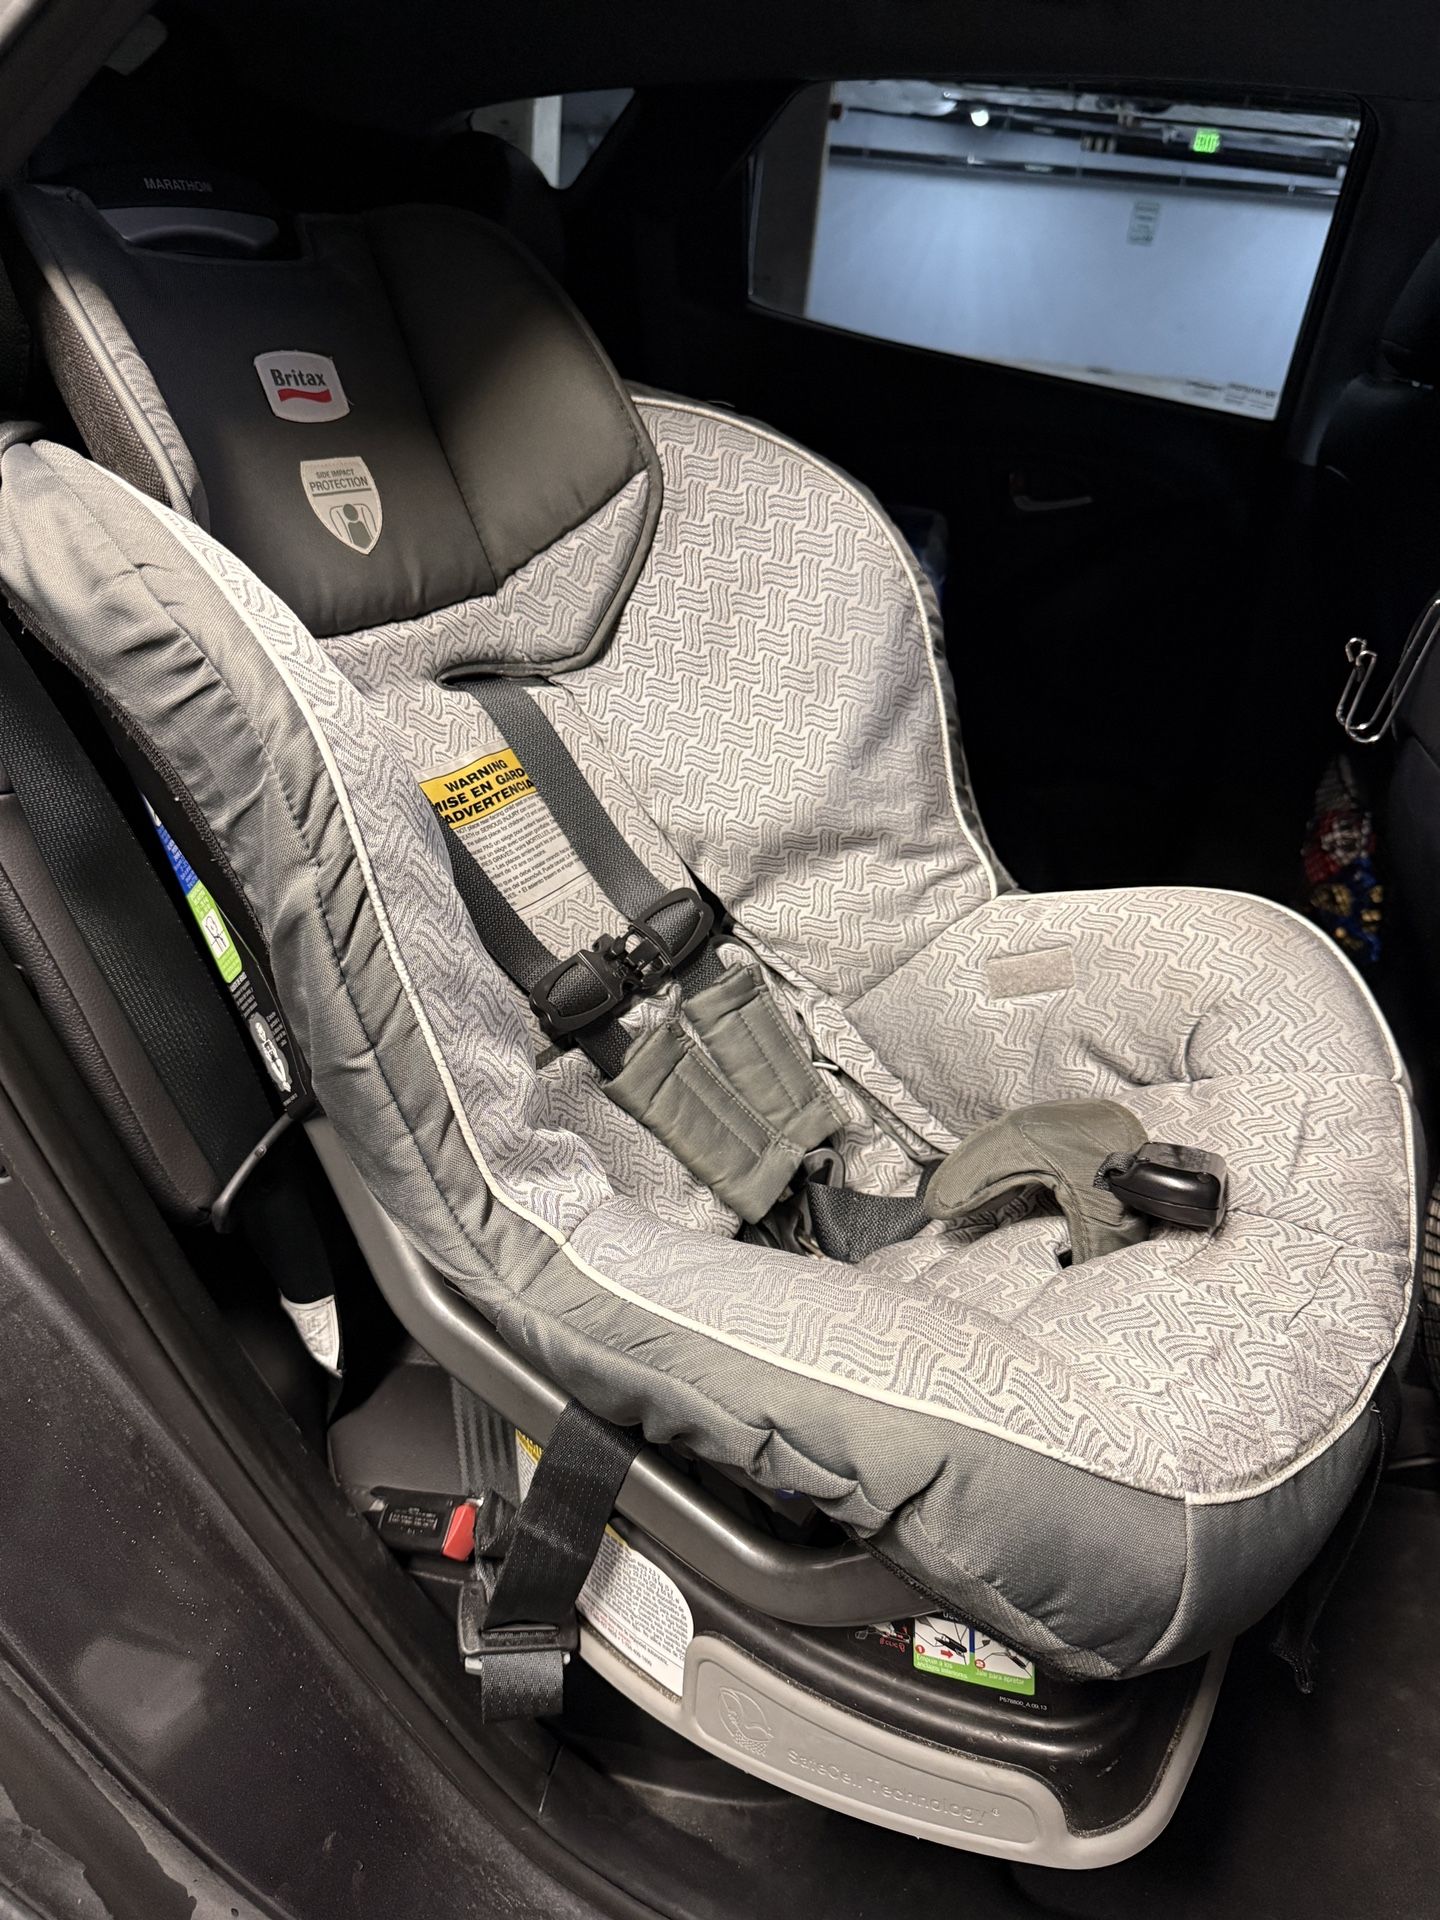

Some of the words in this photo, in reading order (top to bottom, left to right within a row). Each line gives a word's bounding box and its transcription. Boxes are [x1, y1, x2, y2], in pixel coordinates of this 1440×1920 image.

[143, 178, 213, 192] MARATHON
[270, 368, 327, 387] Britax
[316, 471, 331, 479] SIDE
[331, 468, 355, 478] IMPACT
[309, 476, 369, 491] PROTECTION
[444, 760, 508, 793] WARNING
[470, 781, 493, 798] EN
[495, 768, 526, 785] GARD
[443, 779, 534, 824] ADVERTENCIA
